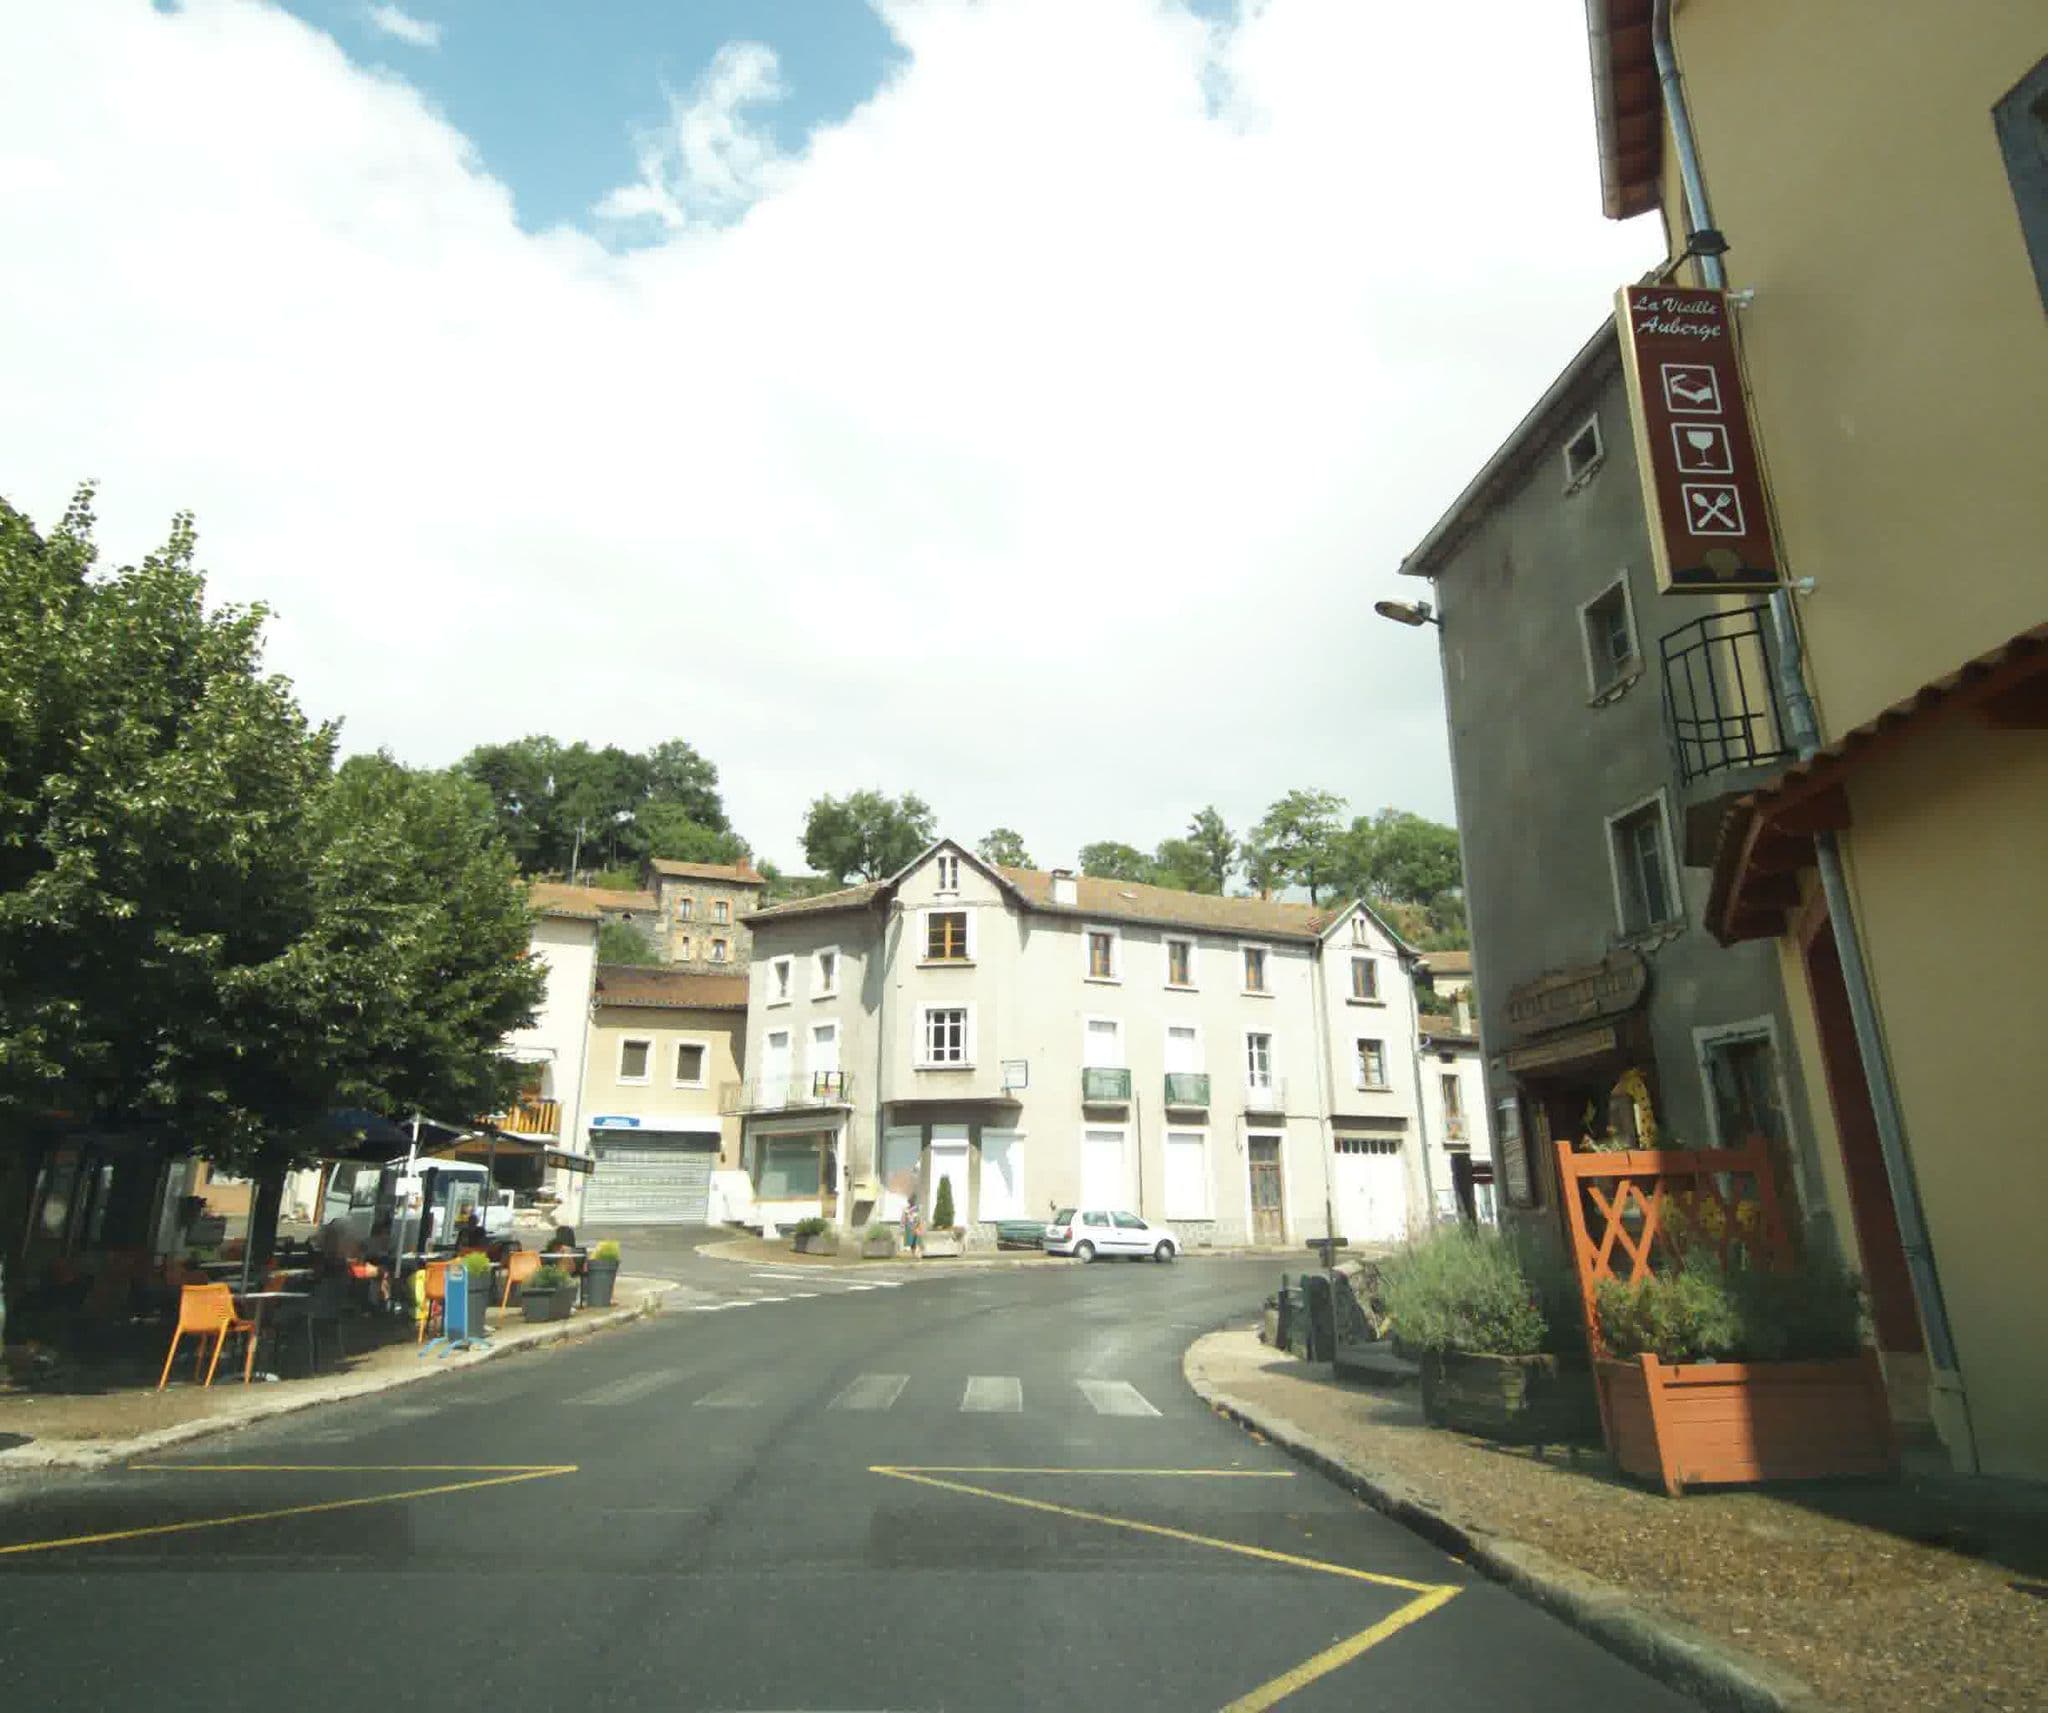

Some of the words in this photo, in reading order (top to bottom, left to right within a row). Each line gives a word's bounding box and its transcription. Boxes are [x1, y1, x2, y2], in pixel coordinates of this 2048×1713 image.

[1633, 295, 1660, 311] La
[1661, 297, 1717, 314] Vieille
[1637, 315, 1721, 342] Auberge
